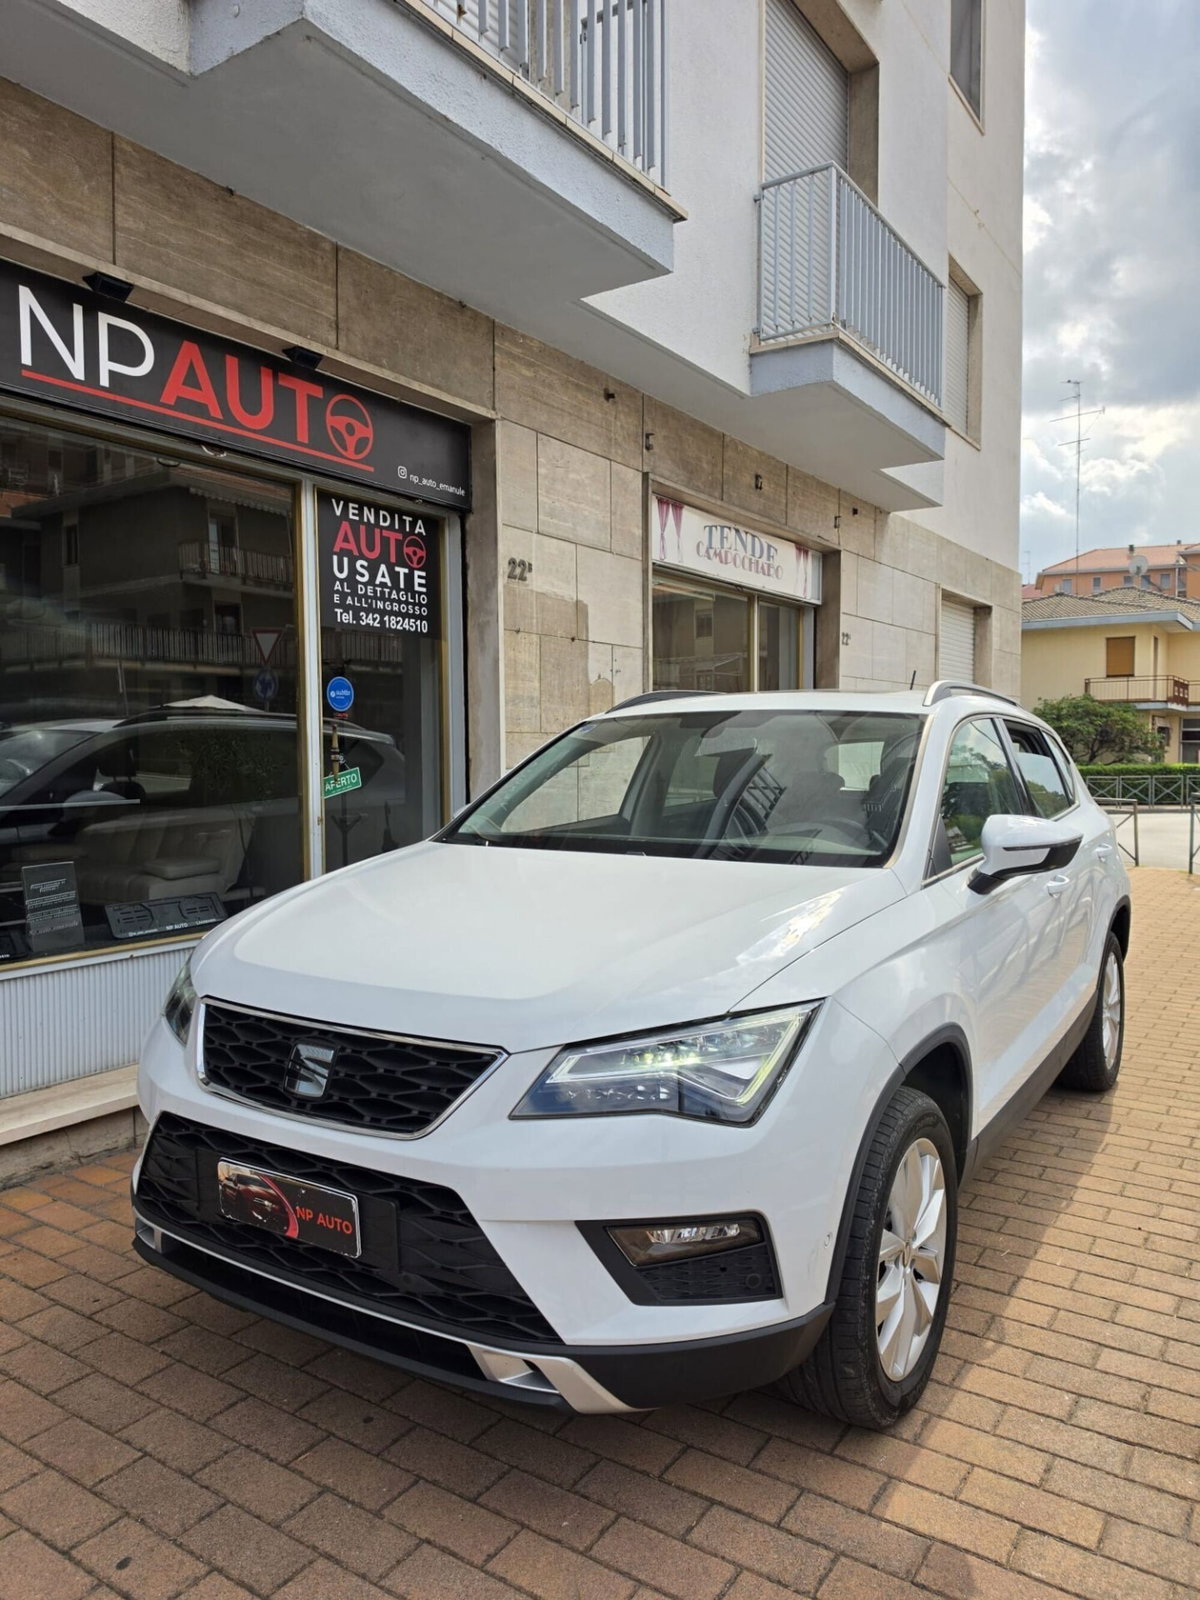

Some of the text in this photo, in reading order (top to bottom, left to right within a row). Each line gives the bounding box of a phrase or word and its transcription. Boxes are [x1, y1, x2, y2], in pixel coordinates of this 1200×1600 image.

[19, 285, 155, 388] NP
[331, 499, 426, 536] VENDITA
[704, 525, 778, 562] TENDE
[332, 555, 427, 592] USATE
[334, 581, 428, 604] AL DETTAGLIO
[334, 594, 428, 616] E ALL'INGROSSO
[334, 608, 428, 634] Tel. 342 1824510
[325, 773, 357, 792] APERTO
[296, 1206, 353, 1235] NP AUTO
